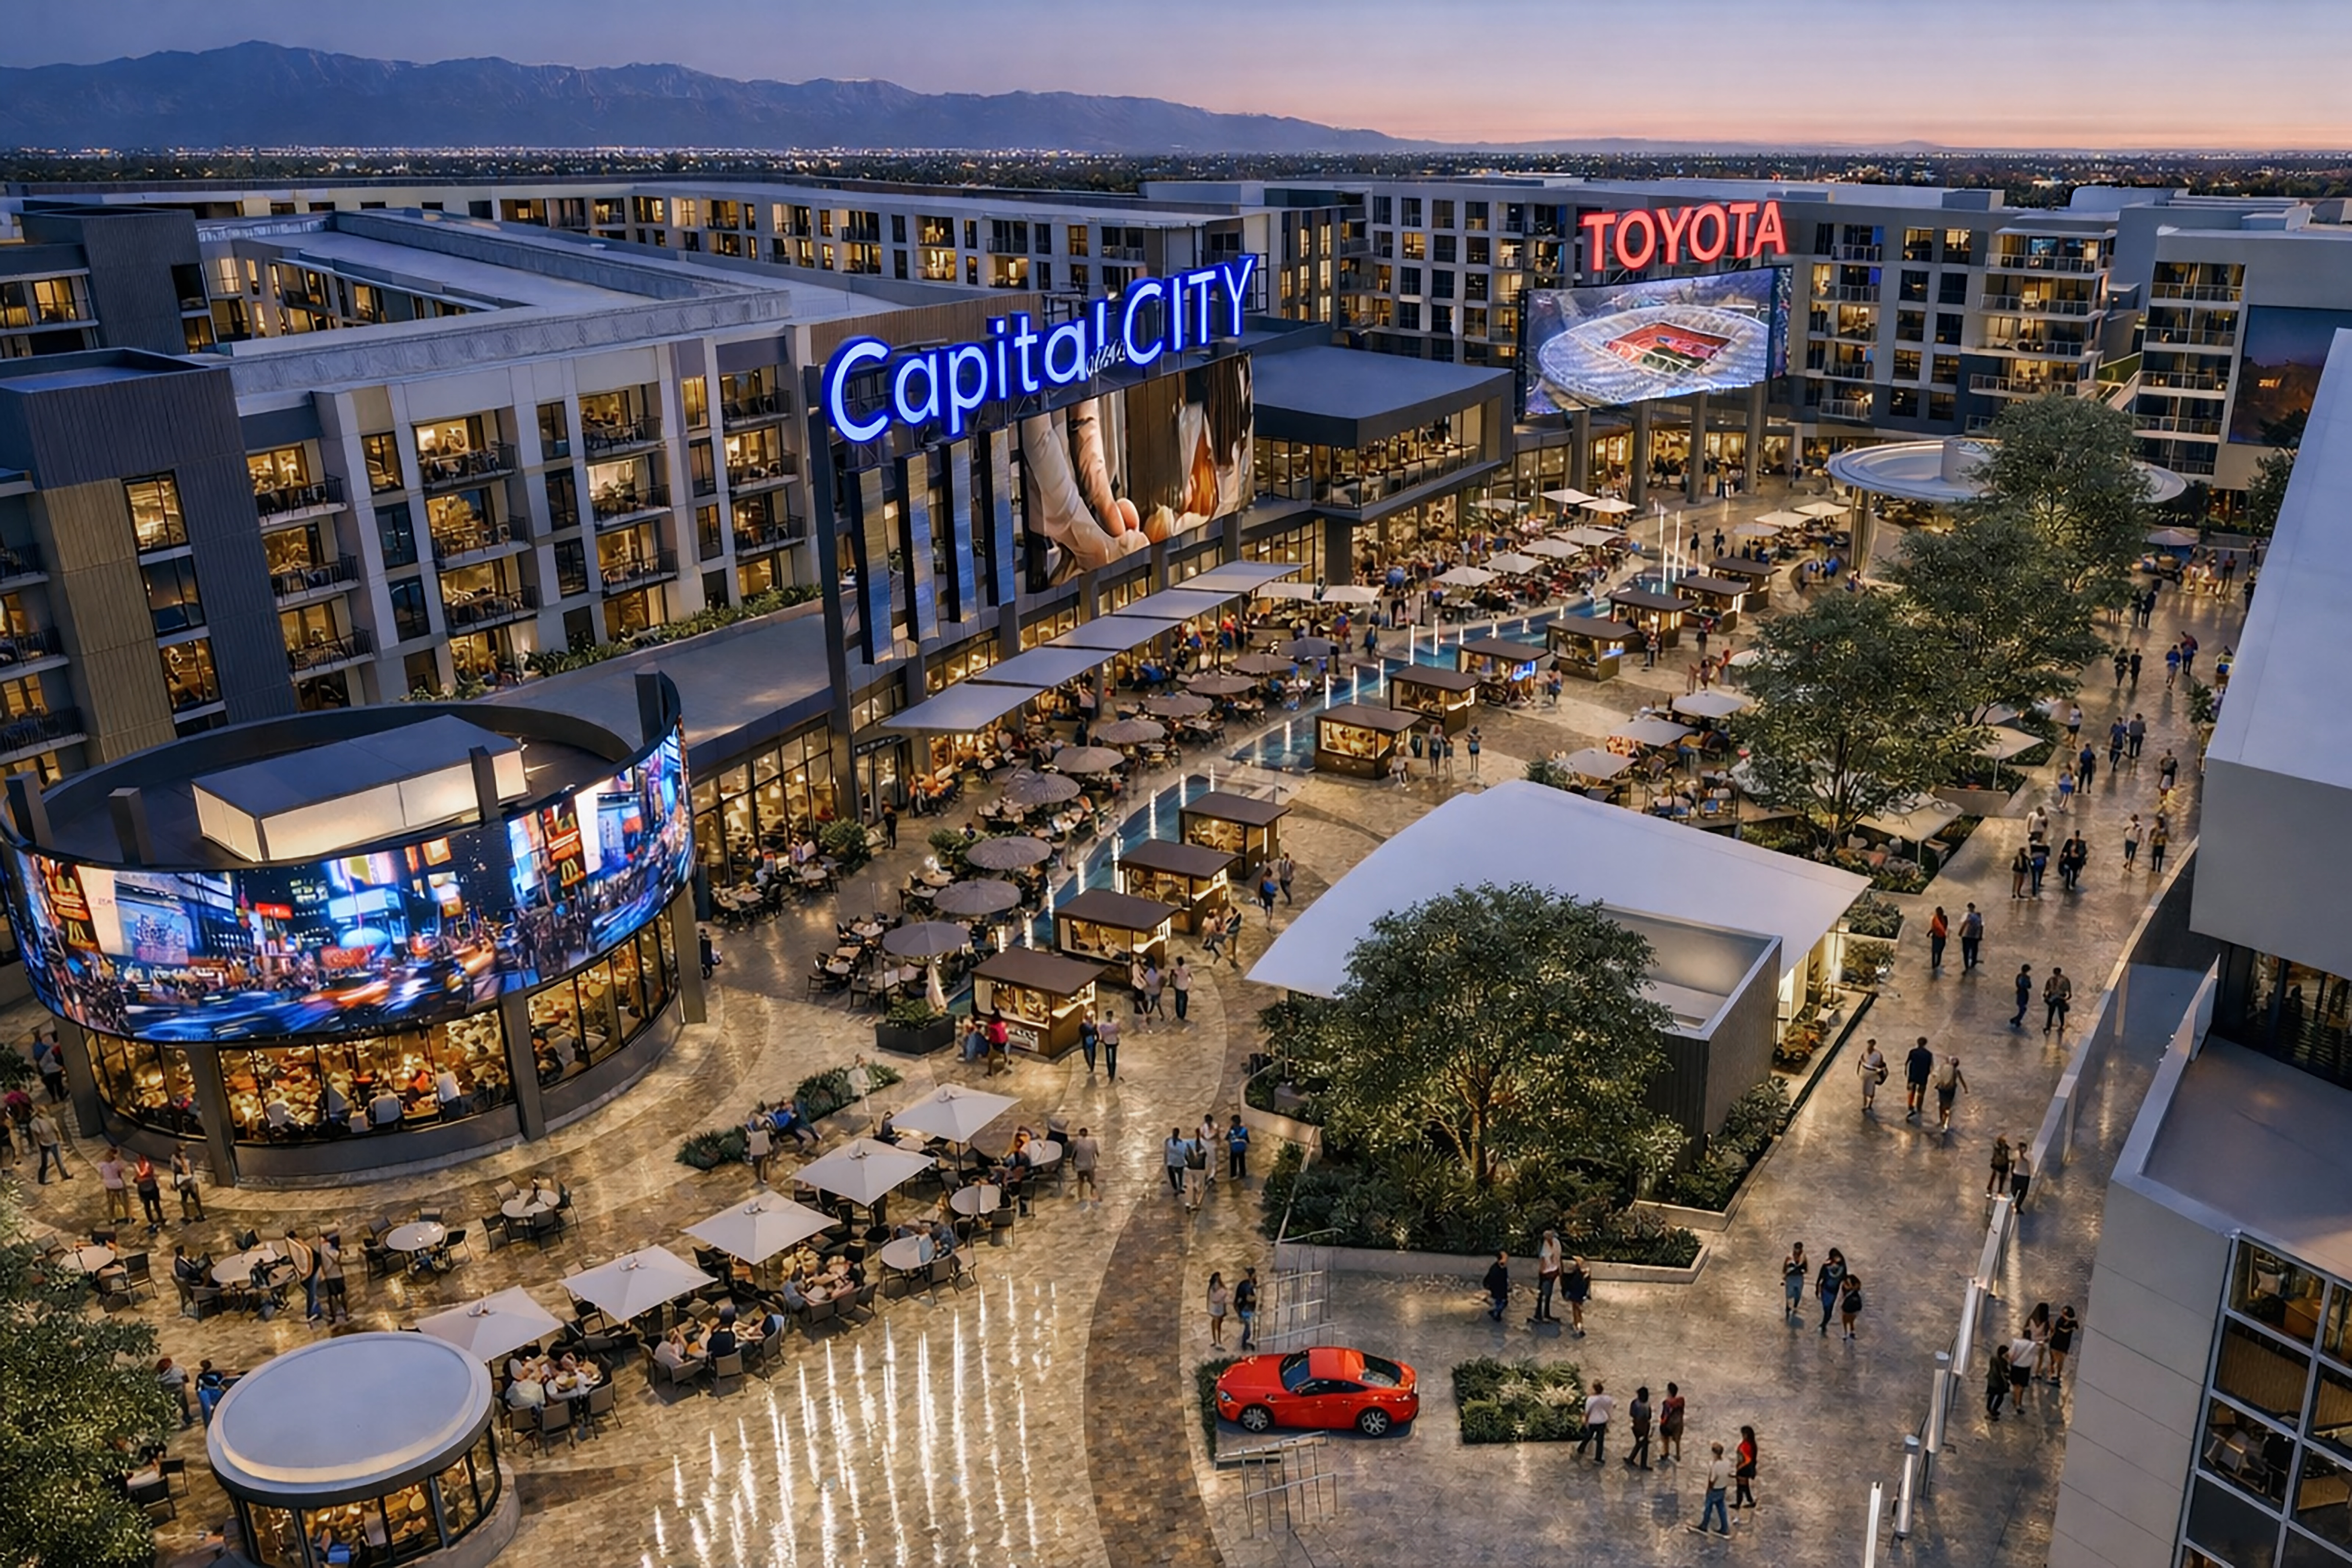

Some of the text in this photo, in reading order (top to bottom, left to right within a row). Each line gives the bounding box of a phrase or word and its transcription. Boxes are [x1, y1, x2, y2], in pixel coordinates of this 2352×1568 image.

[1580, 202, 1786, 271] TOYOTA
[827, 254, 1257, 442] Capital CITY
